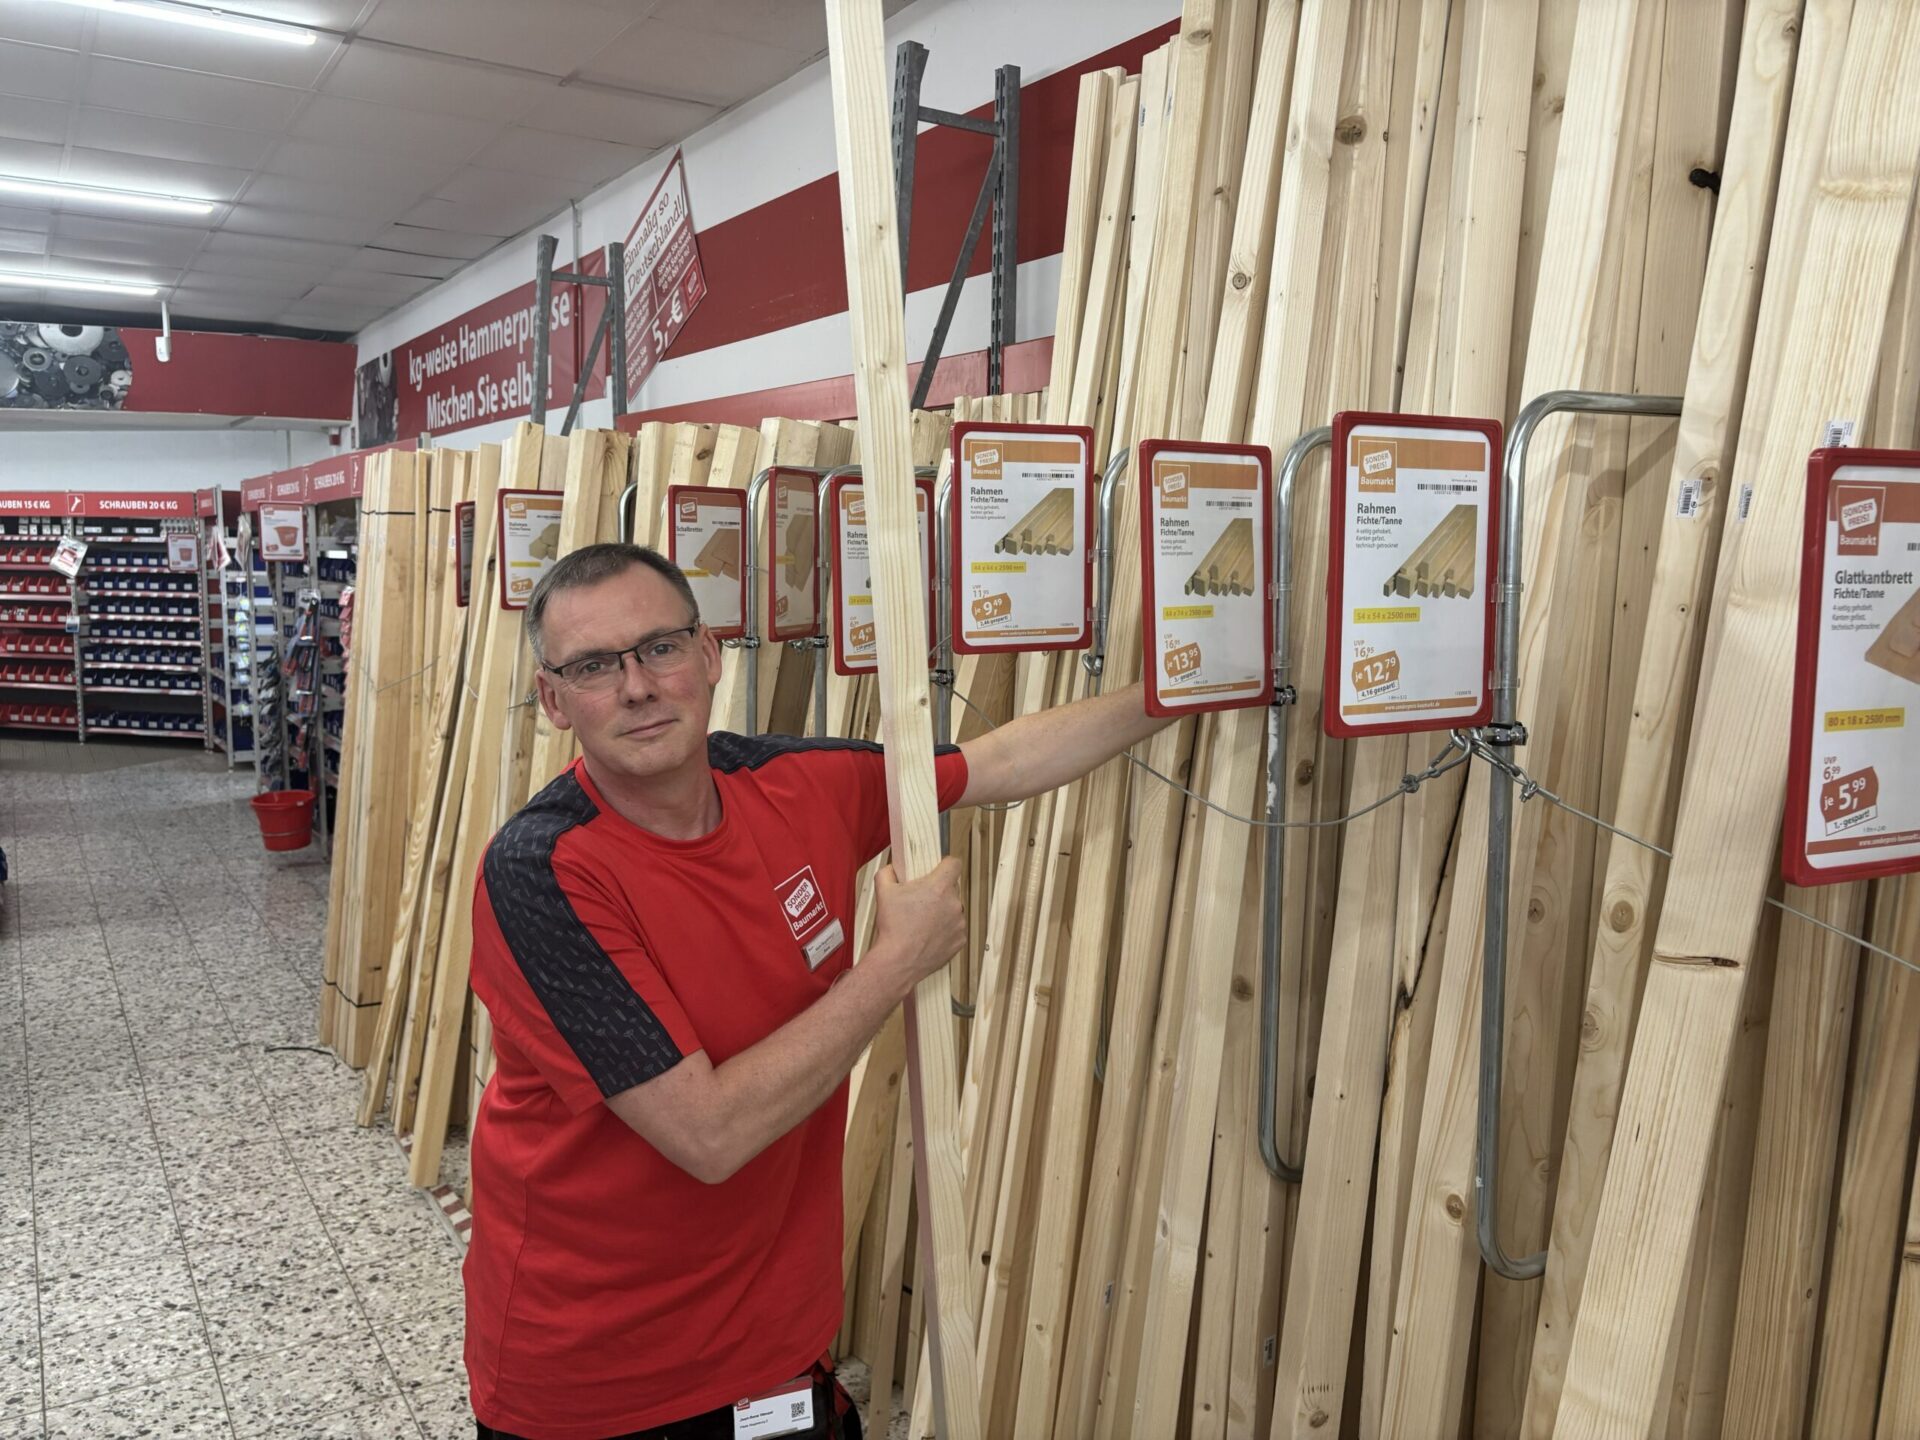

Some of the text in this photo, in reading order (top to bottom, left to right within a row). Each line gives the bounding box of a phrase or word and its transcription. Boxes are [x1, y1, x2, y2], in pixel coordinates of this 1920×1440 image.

[624, 209, 659, 275] Einmalig
[659, 192, 669, 216] so
[628, 194, 683, 296] Deutschland!
[409, 336, 457, 392] kg-weise
[459, 291, 571, 365] Hammerprse
[427, 354, 553, 430] Mischen Sie selb!
[1365, 452, 1389, 465] SONDER
[1368, 461, 1387, 472] PREIS!
[1360, 476, 1394, 486] Baumarkt
[970, 486, 1003, 496] Rahmen
[40, 500, 51, 509] KG
[99, 500, 148, 510] SCHRAUBEN
[149, 500, 158, 510] 20
[166, 501, 178, 510] KG
[970, 496, 1009, 504] Fichte/Tanne
[1162, 495, 1187, 503] Baumarkt
[1357, 503, 1397, 514] Rahmen
[1843, 502, 1874, 518] SONDER
[1160, 517, 1190, 527] Rahmen
[1356, 515, 1403, 526] Fichte/Tanne
[1848, 512, 1870, 527] PREIS!
[847, 531, 868, 539] Rahme
[1160, 528, 1195, 537] Fichte/Tanne
[1839, 534, 1877, 546] Baumarkt
[1834, 570, 1913, 585] Glattkantbrett
[1833, 588, 1885, 599] Fichte/Tanne
[983, 598, 1002, 616] 9,49
[1372, 612, 1381, 620] 54
[1386, 611, 1404, 620] 2500
[1173, 647, 1198, 671] 13,95
[1354, 647, 1374, 660] 16,95
[1354, 656, 1396, 684] je 12,79
[1361, 682, 1396, 698] 4,16 gespart!
[1864, 714, 1884, 724] 2500
[1824, 756, 1838, 765] UVP
[1823, 766, 1841, 781] 6,99
[1823, 777, 1867, 811] je 5,99
[1843, 809, 1870, 828] gespart!
[787, 881, 809, 909] SONDER
[795, 891, 811, 912] PREIS!
[792, 901, 824, 932] Baumarkt
